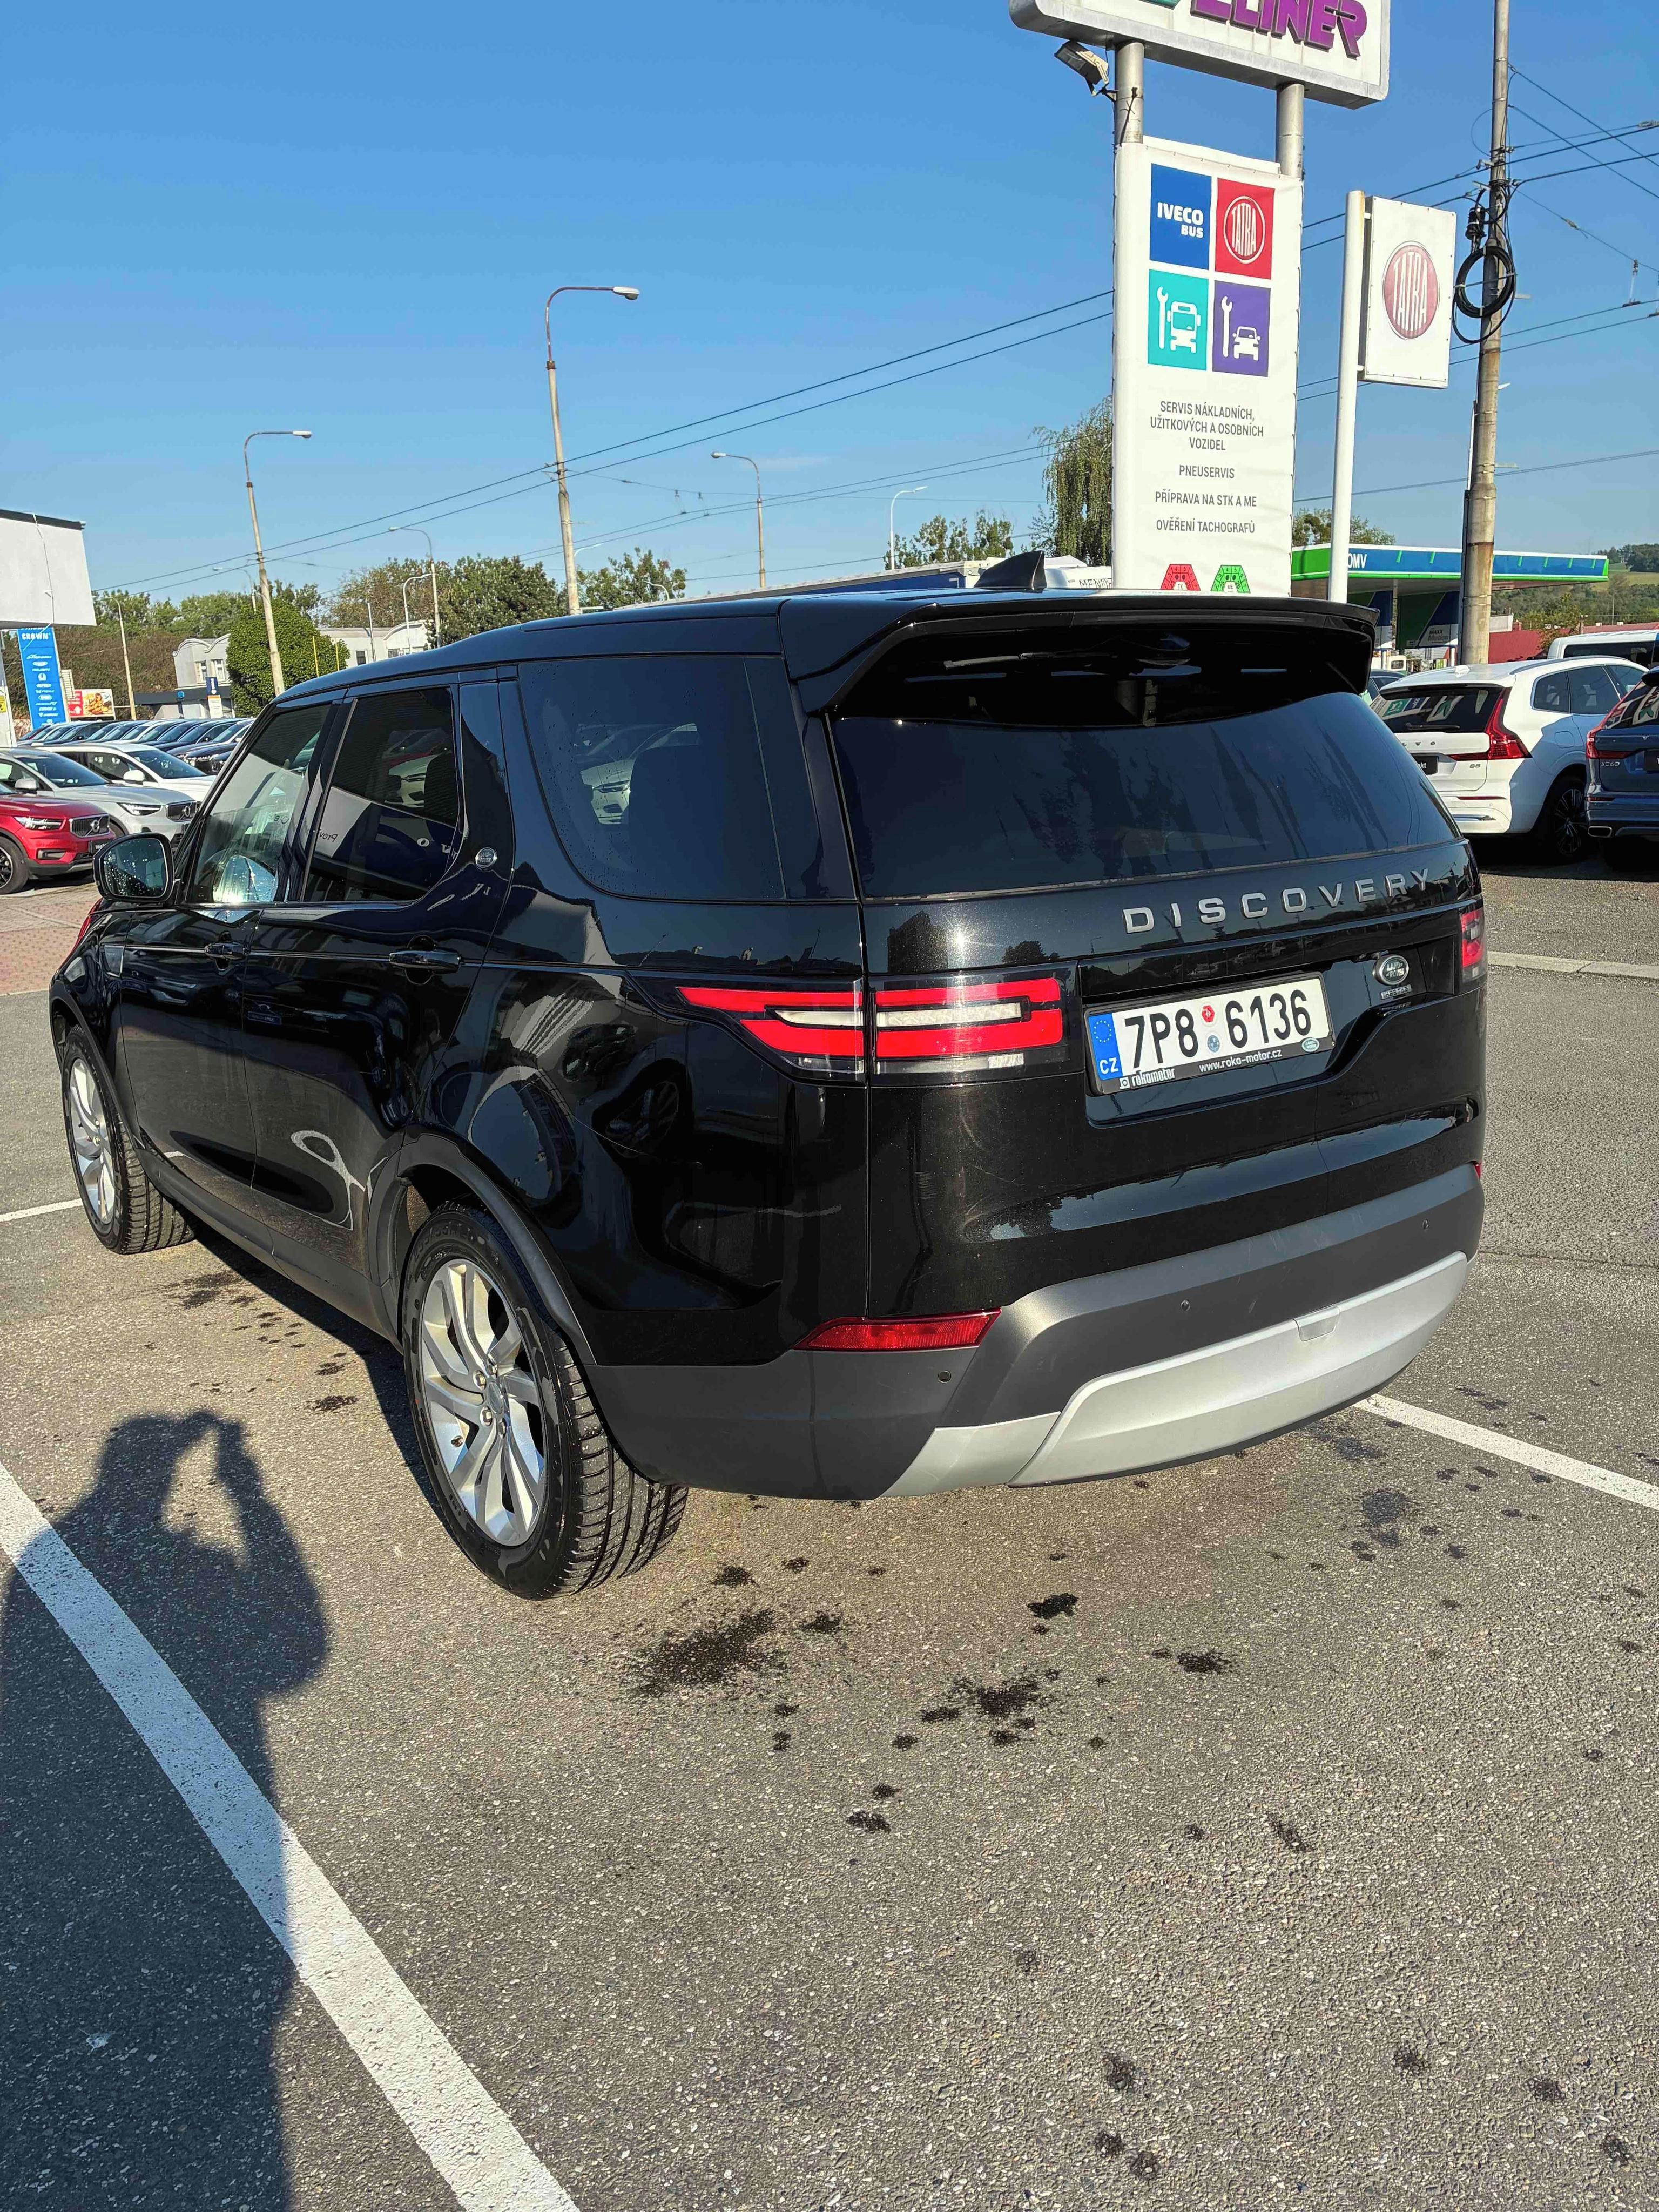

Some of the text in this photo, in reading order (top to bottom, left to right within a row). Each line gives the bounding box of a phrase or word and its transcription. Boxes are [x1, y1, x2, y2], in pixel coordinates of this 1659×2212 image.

[1157, 202, 1203, 225] IVECO
[1181, 224, 1203, 238] BUS
[1231, 203, 1256, 257] TATRA
[1393, 252, 1428, 332] TATRA
[1161, 401, 1255, 422] SERVIS NÁKLADNÍCH,
[1150, 414, 1264, 437] UŽITKOVÝCH A OSOBNÍCH
[1189, 437, 1226, 450] VOZIDEL
[1179, 465, 1235, 478] PNEUSERVIS
[1155, 488, 1257, 507] PŘÍPRAVA NA STK A ME
[1156, 517, 1255, 533] OVĚŘENÍ TACHOGRAFŮ
[1348, 553, 1367, 569] OMV
[1122, 868, 1428, 934] DISCOVERY
[1124, 989, 1311, 1069] 7P8 6136
[1100, 1058, 1118, 1074] CZ
[1199, 1049, 1283, 1073] www.roko-motor.cz
[1131, 1068, 1175, 1087] rokomotor
